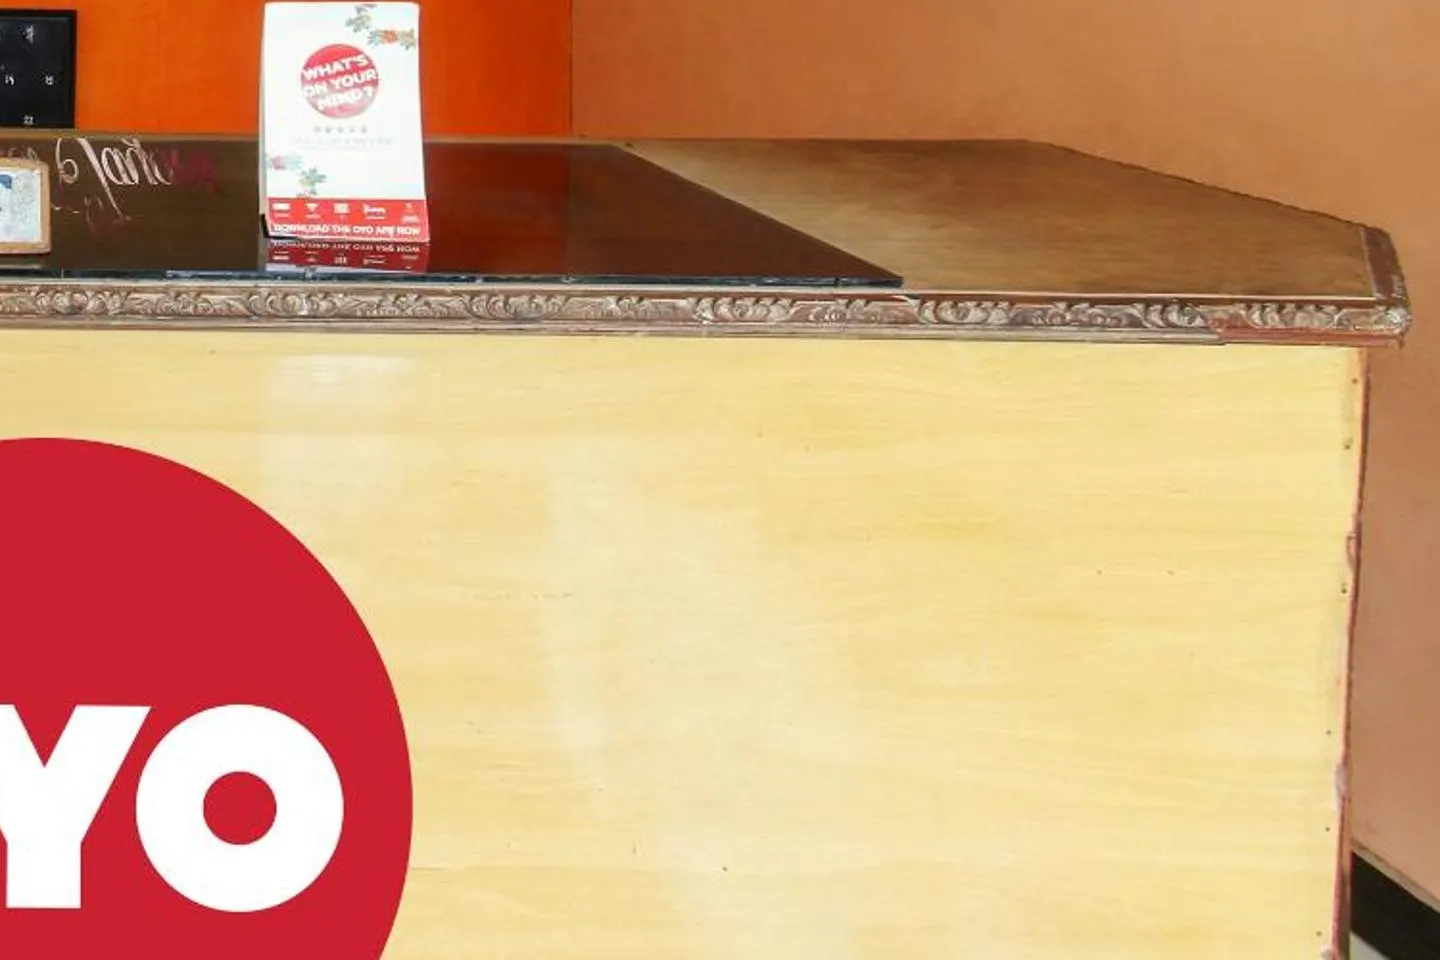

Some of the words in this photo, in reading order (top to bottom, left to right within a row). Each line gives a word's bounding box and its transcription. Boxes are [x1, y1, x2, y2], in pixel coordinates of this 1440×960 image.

[302, 54, 369, 80] WHAT'S
[304, 81, 329, 98] ON
[329, 69, 377, 89] YOUR
[273, 224, 329, 234] DOWNLOAD
[397, 226, 421, 236] NOW
